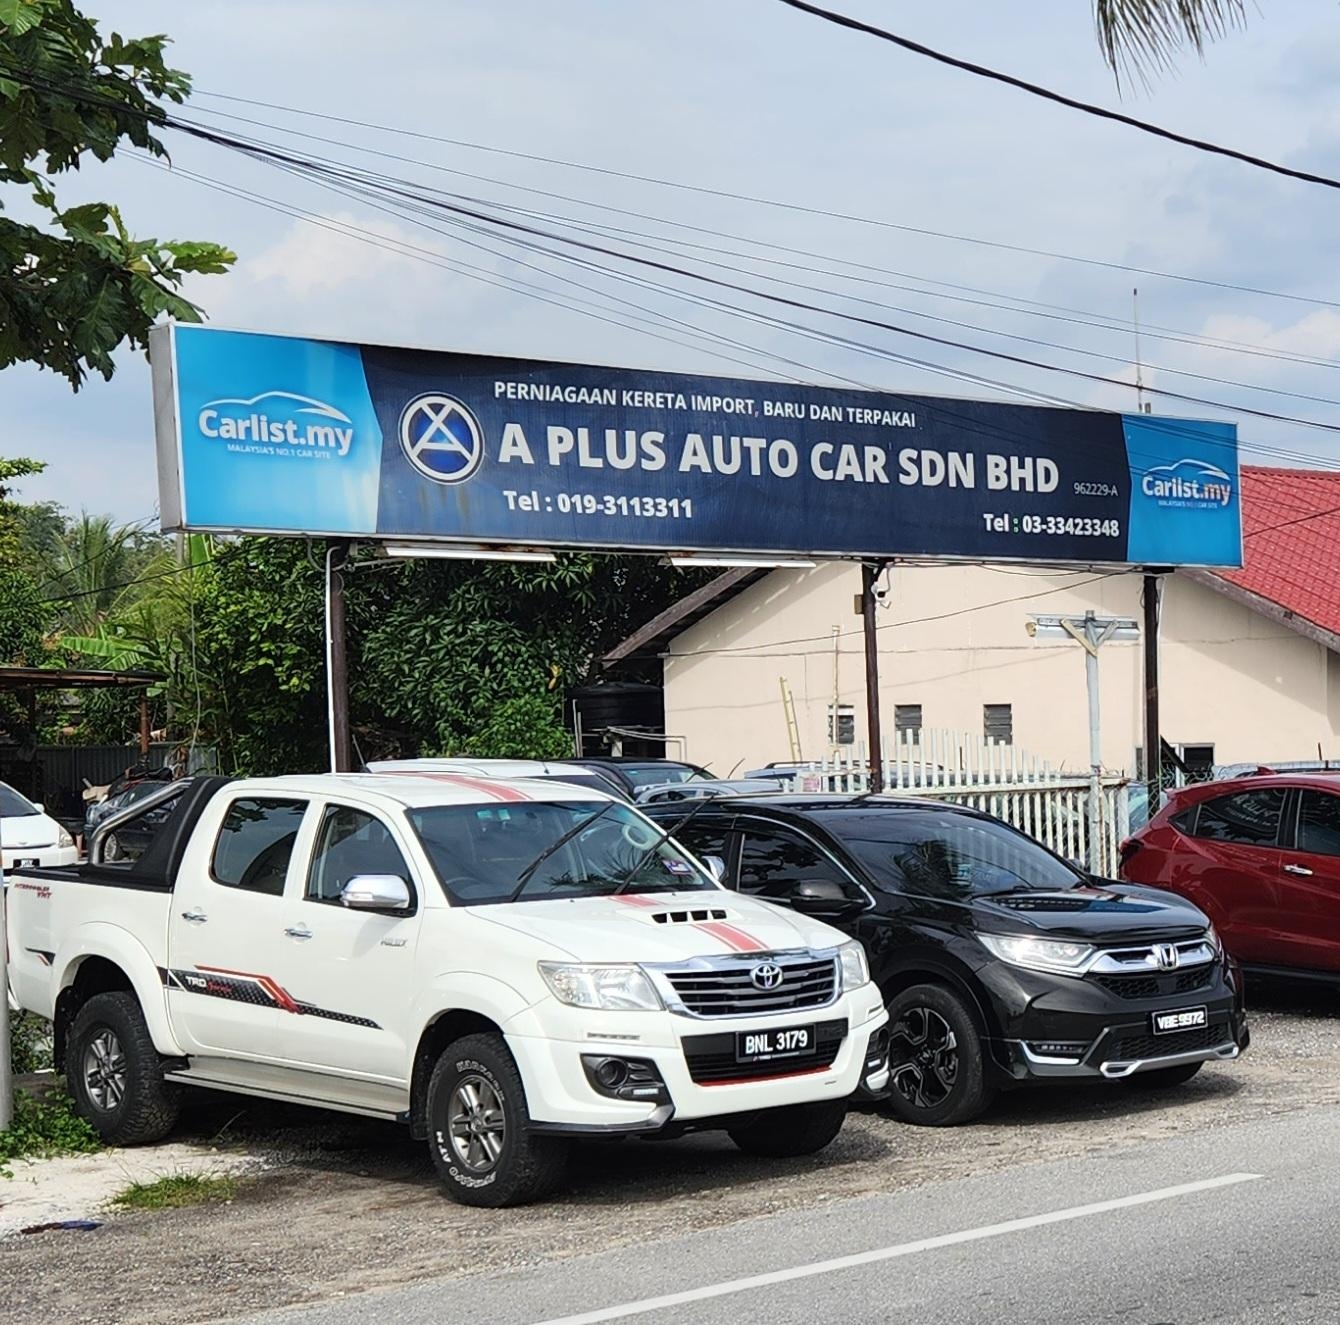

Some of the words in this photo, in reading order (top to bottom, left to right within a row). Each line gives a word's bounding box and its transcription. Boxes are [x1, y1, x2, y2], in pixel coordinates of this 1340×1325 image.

[494, 381, 617, 406] PERNIAGAAN
[622, 390, 687, 410] KERETA
[692, 395, 758, 418] IMPORT,
[763, 401, 805, 419] BARU
[809, 404, 843, 422] DAN
[846, 408, 915, 428] TERPAKAI
[198, 409, 353, 456] Carlist.my
[498, 423, 535, 465] A
[546, 426, 666, 471] PLUS
[679, 433, 799, 478] AUTO
[810, 442, 890, 484] CAR
[899, 448, 976, 488] SDN
[986, 454, 1060, 493] BHD
[1073, 482, 1119, 497] 962229-A
[503, 490, 538, 512] Tel
[557, 493, 693, 519] 019-3113311
[1142, 476, 1232, 506] Carlist.my
[983, 513, 1009, 532] Tel
[1022, 515, 1120, 537] 03-33423348
[745, 1034, 773, 1054] BNL
[776, 1029, 808, 1050] 3179
